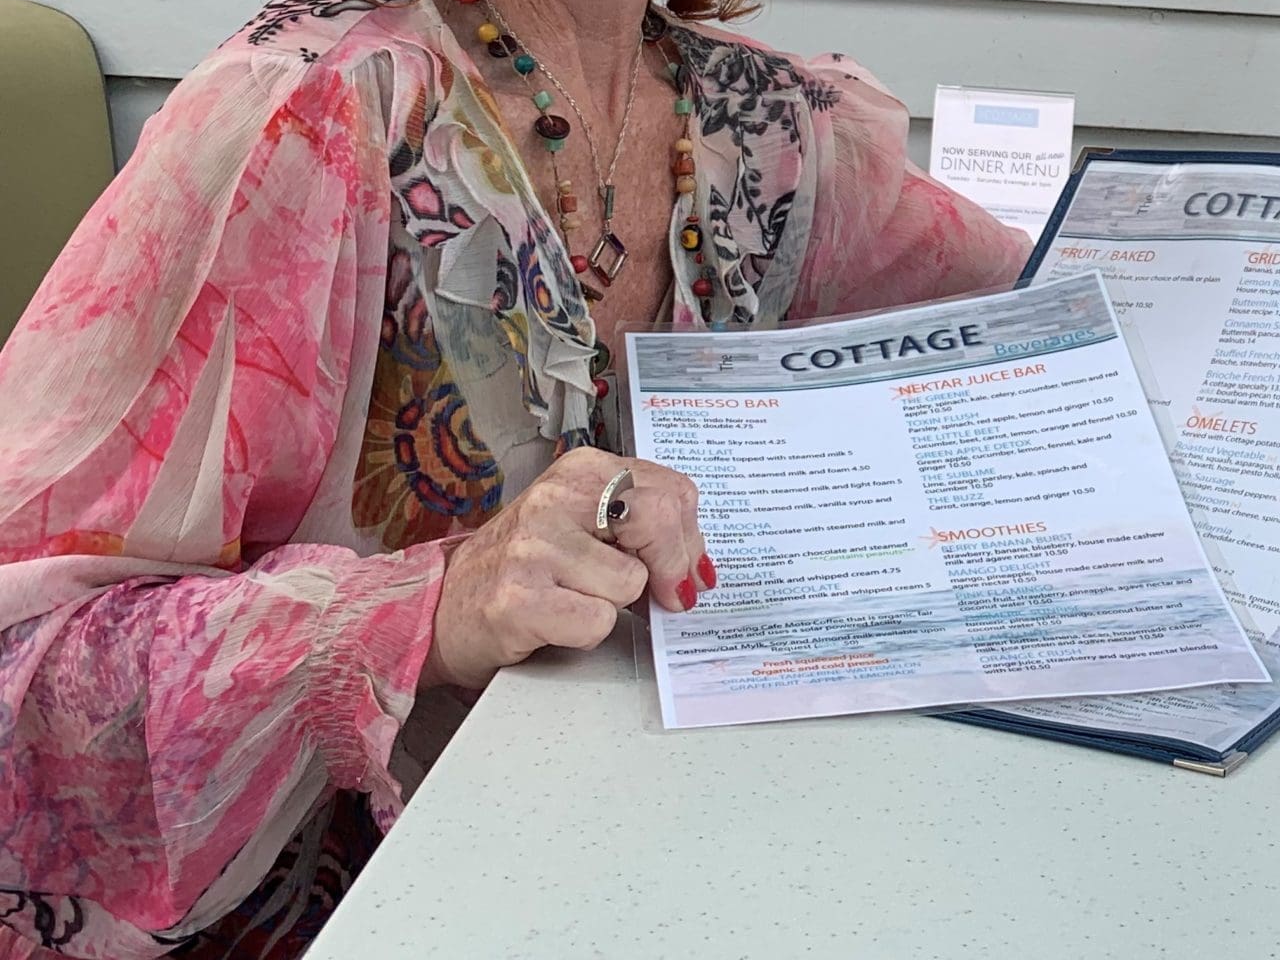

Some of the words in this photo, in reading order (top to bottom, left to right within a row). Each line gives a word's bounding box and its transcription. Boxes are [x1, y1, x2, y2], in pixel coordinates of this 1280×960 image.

[943, 147, 965, 156] NOW
[968, 148, 1008, 159] SERVING
[1011, 152, 1031, 160] OUR
[941, 157, 1004, 174] DINNER
[1010, 163, 1060, 178] MENU
[1137, 194, 1153, 215] The
[1059, 247, 1101, 260] FRUIT
[1109, 250, 1156, 262] BAKED
[1238, 276, 1272, 287] Lemon
[1231, 297, 1279, 309] Buttermilk
[1250, 308, 1274, 317] recipe
[1223, 318, 1272, 330] Cinnamon
[720, 354, 734, 371] The
[780, 324, 984, 372] COTTAGE
[994, 326, 1096, 357] Beverages
[1213, 348, 1248, 358] Stuffed
[898, 376, 962, 395] NEKTAR
[968, 369, 1009, 384] JUICE
[1014, 363, 1046, 377] BAR
[650, 398, 739, 407] ESPRESSO
[745, 399, 779, 407] BAR
[902, 396, 922, 406] THE
[925, 390, 971, 402] GREENIE
[907, 416, 941, 427] TOXIN
[943, 411, 979, 422] FLUSH
[1185, 415, 1259, 434] OMELETS
[911, 434, 932, 443] THE
[935, 429, 971, 440] LITTLE
[974, 426, 999, 435] BEET
[1181, 429, 1208, 438] Served
[1207, 432, 1225, 440] with
[1224, 434, 1256, 445] Cottage
[915, 448, 953, 460] GREEN
[956, 443, 990, 454] APPLE
[993, 438, 1031, 449] DETOX
[1174, 442, 1216, 454] Roasted
[1214, 447, 1267, 462] Vegetable
[921, 473, 943, 482] THE
[946, 467, 996, 479] SUBLIME
[929, 496, 950, 505] THE
[953, 492, 984, 502] BUZZ
[994, 495, 1023, 503] lemon
[1042, 489, 1070, 500] ginger
[1073, 486, 1095, 495] 10.50
[937, 521, 1047, 542] SMOOTHIES
[941, 542, 978, 552] BERRY
[981, 537, 1033, 549] BANANA
[1035, 533, 1072, 544] BURST
[948, 565, 997, 576] MANGO
[999, 560, 1051, 572] DELIGHT
[979, 651, 1035, 663] ORANGE
[1037, 647, 1082, 658] CRUSH
